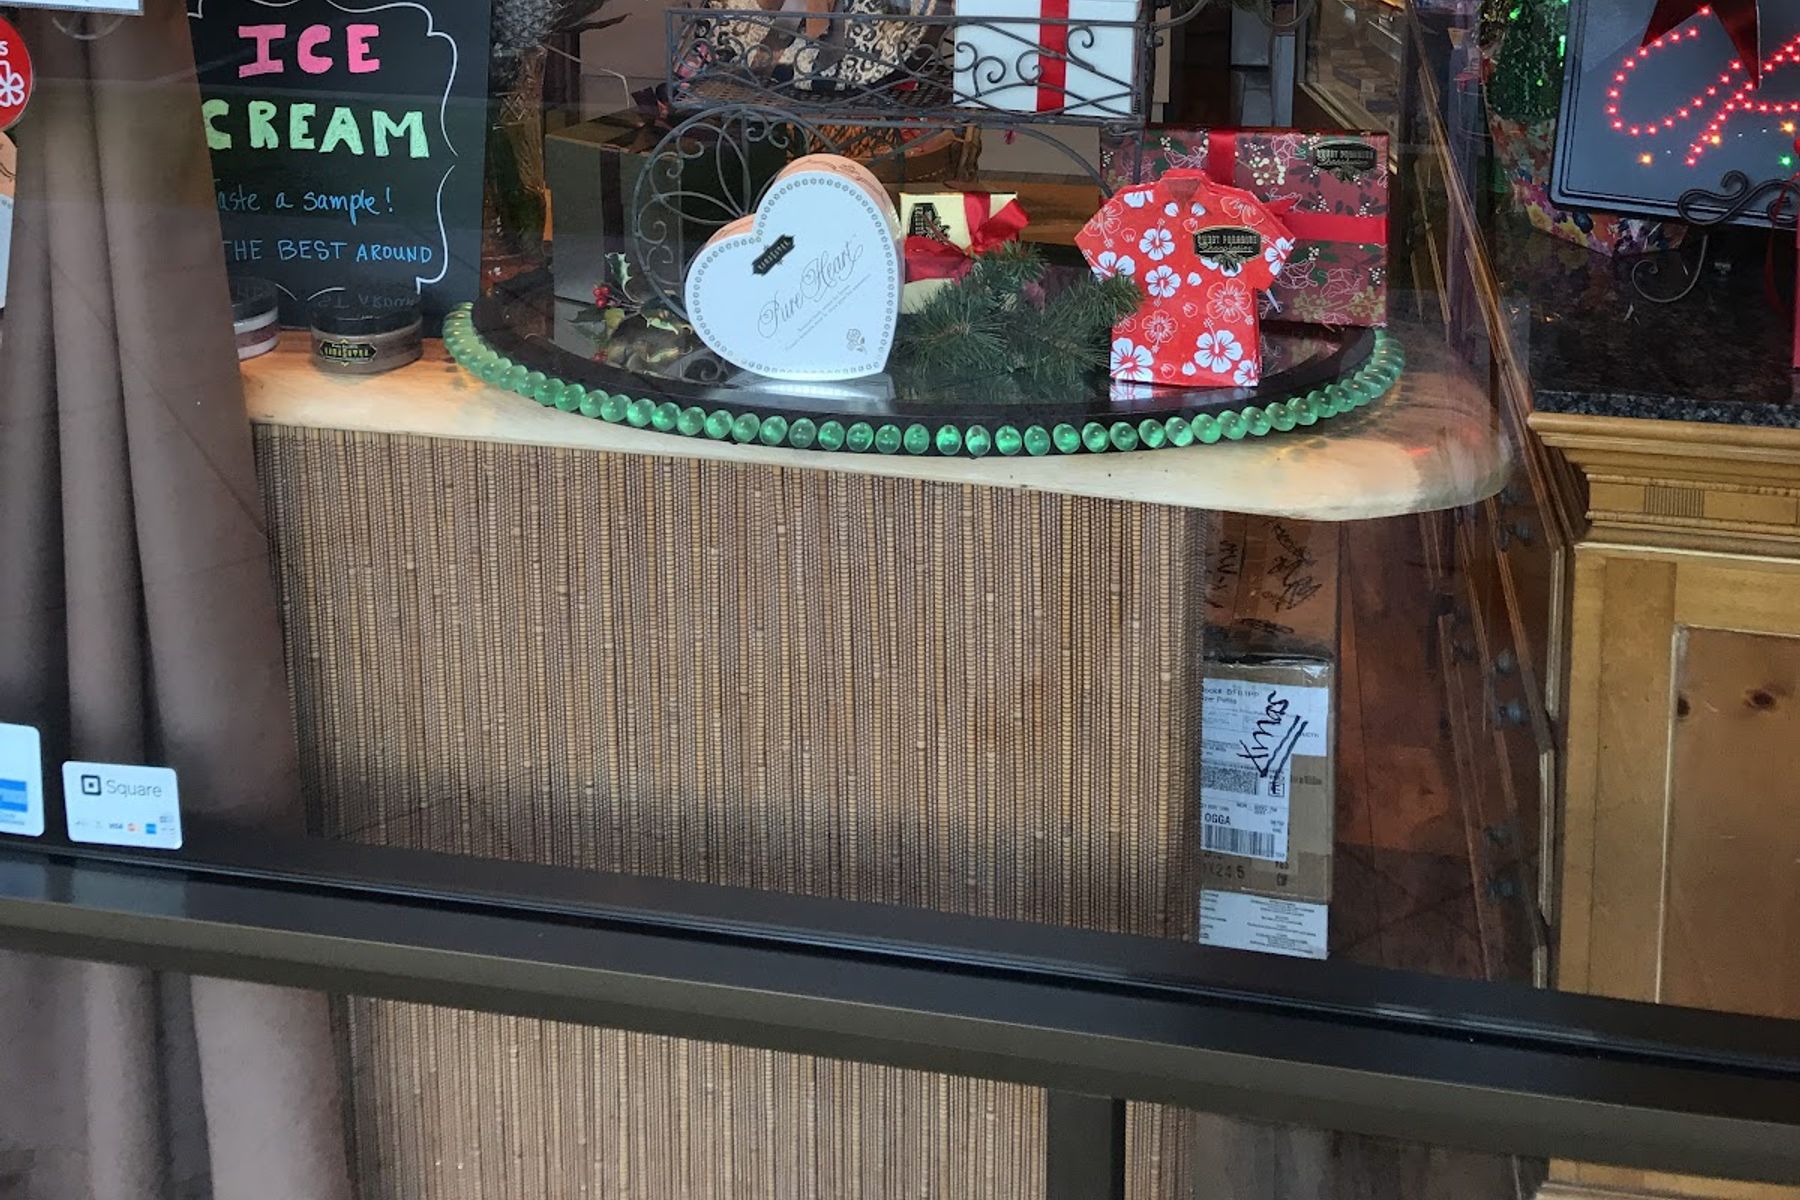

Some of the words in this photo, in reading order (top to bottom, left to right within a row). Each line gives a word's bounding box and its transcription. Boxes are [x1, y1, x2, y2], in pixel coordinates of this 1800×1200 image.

[238, 23, 381, 78] ICE
[201, 99, 429, 158] CREAM
[214, 178, 260, 212] aste
[275, 191, 293, 209] a
[277, 239, 348, 261] BEST
[356, 243, 432, 264] AROUND
[105, 779, 162, 798] Square
